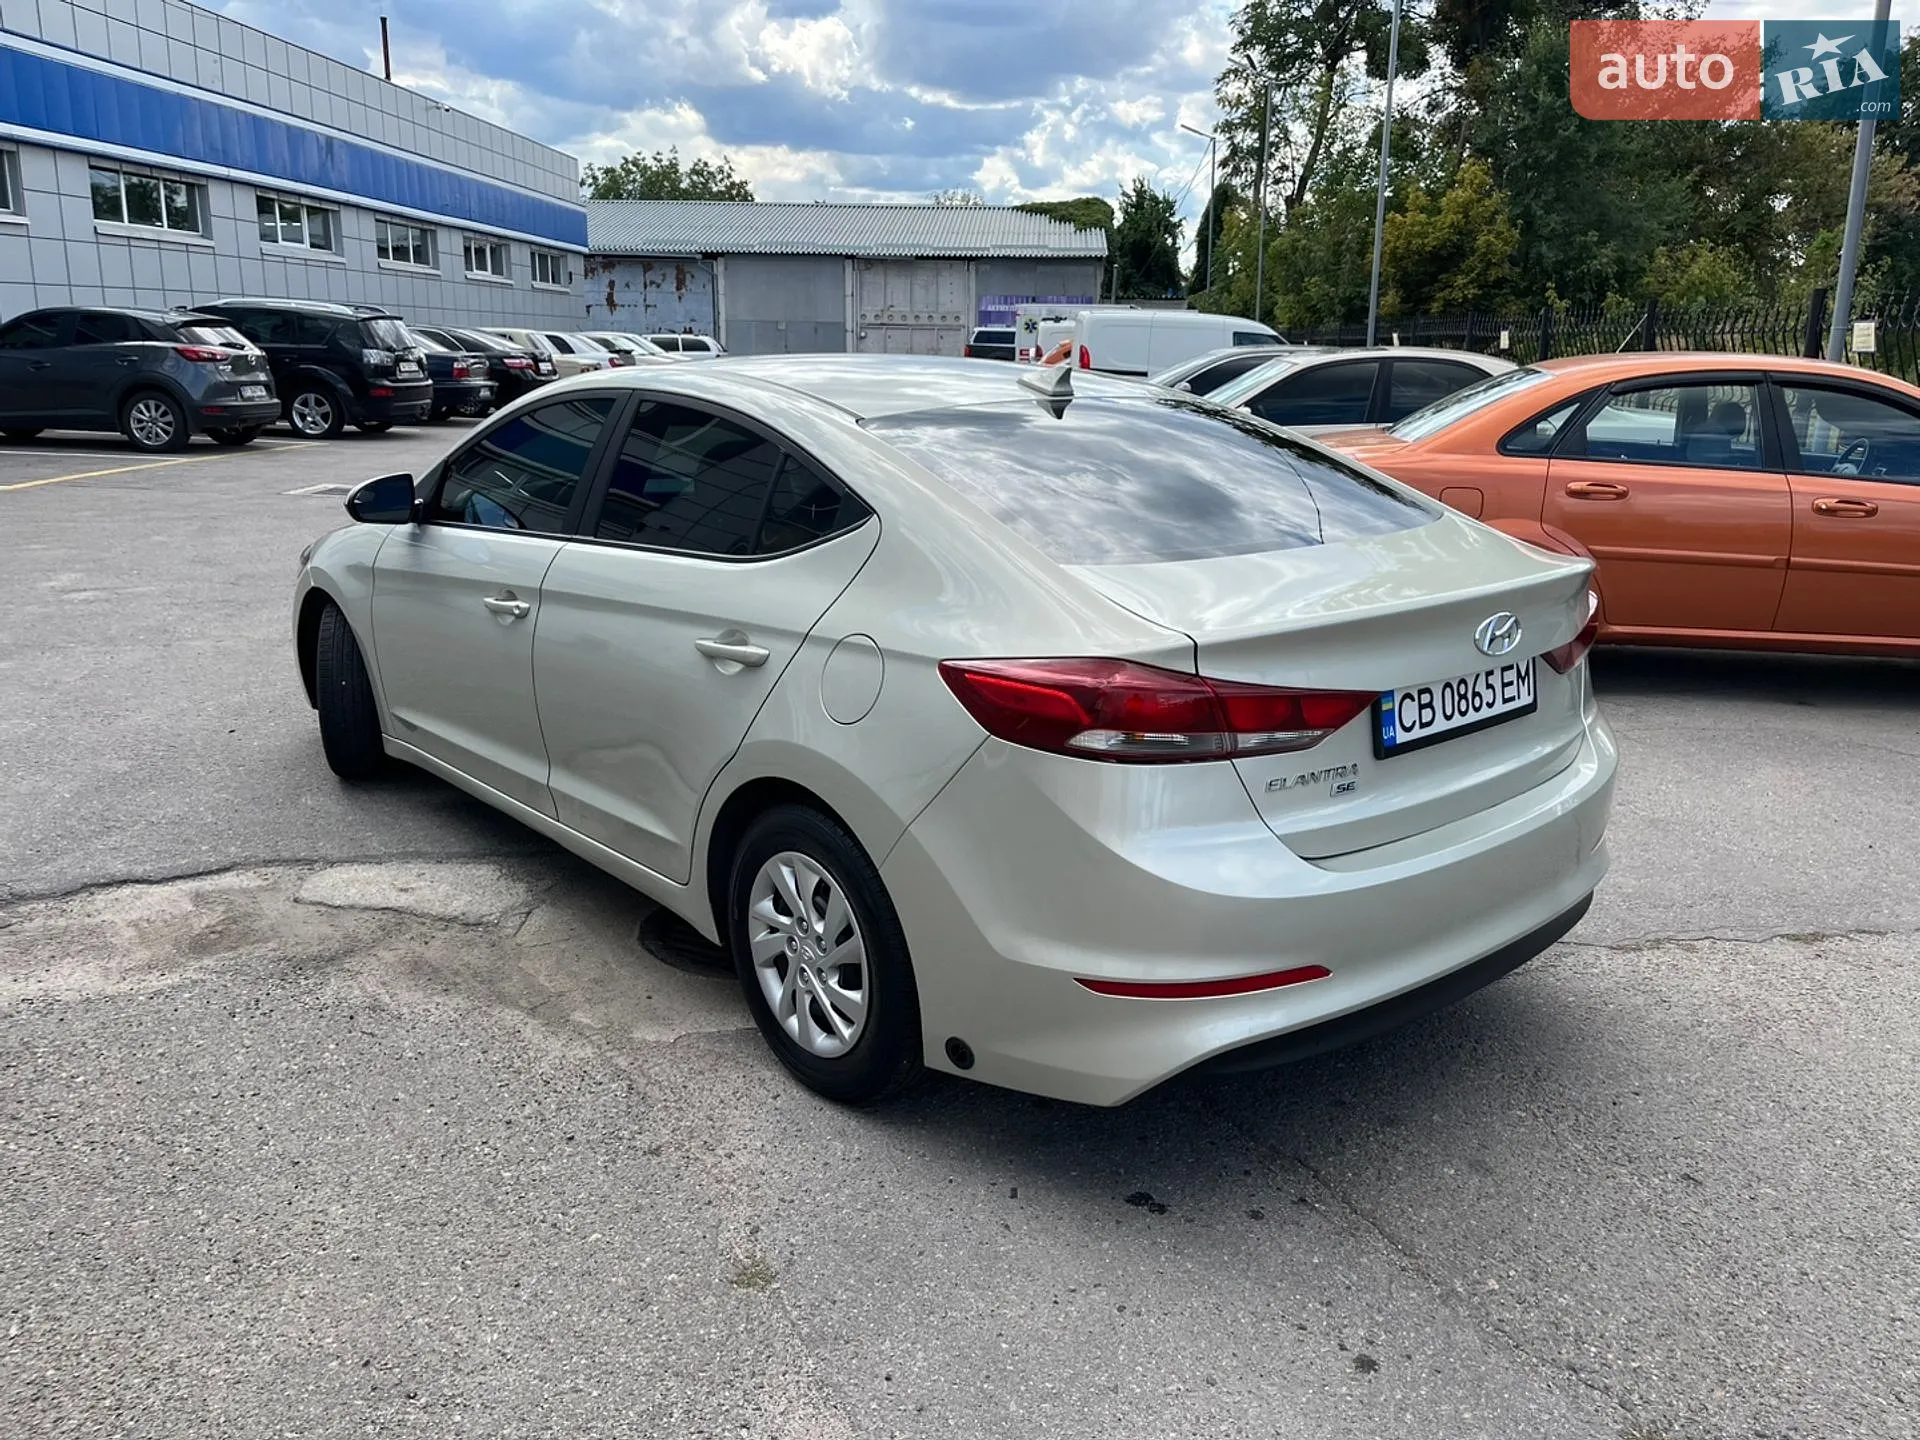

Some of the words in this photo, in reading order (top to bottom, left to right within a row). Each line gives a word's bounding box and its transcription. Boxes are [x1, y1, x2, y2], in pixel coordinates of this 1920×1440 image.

[1398, 686, 1436, 733] CB
[1441, 668, 1497, 722] 0865
[1500, 659, 1531, 705] EM
[1382, 726, 1396, 740] UA
[1264, 762, 1360, 793] ELANTRA
[1335, 781, 1357, 794] SE
